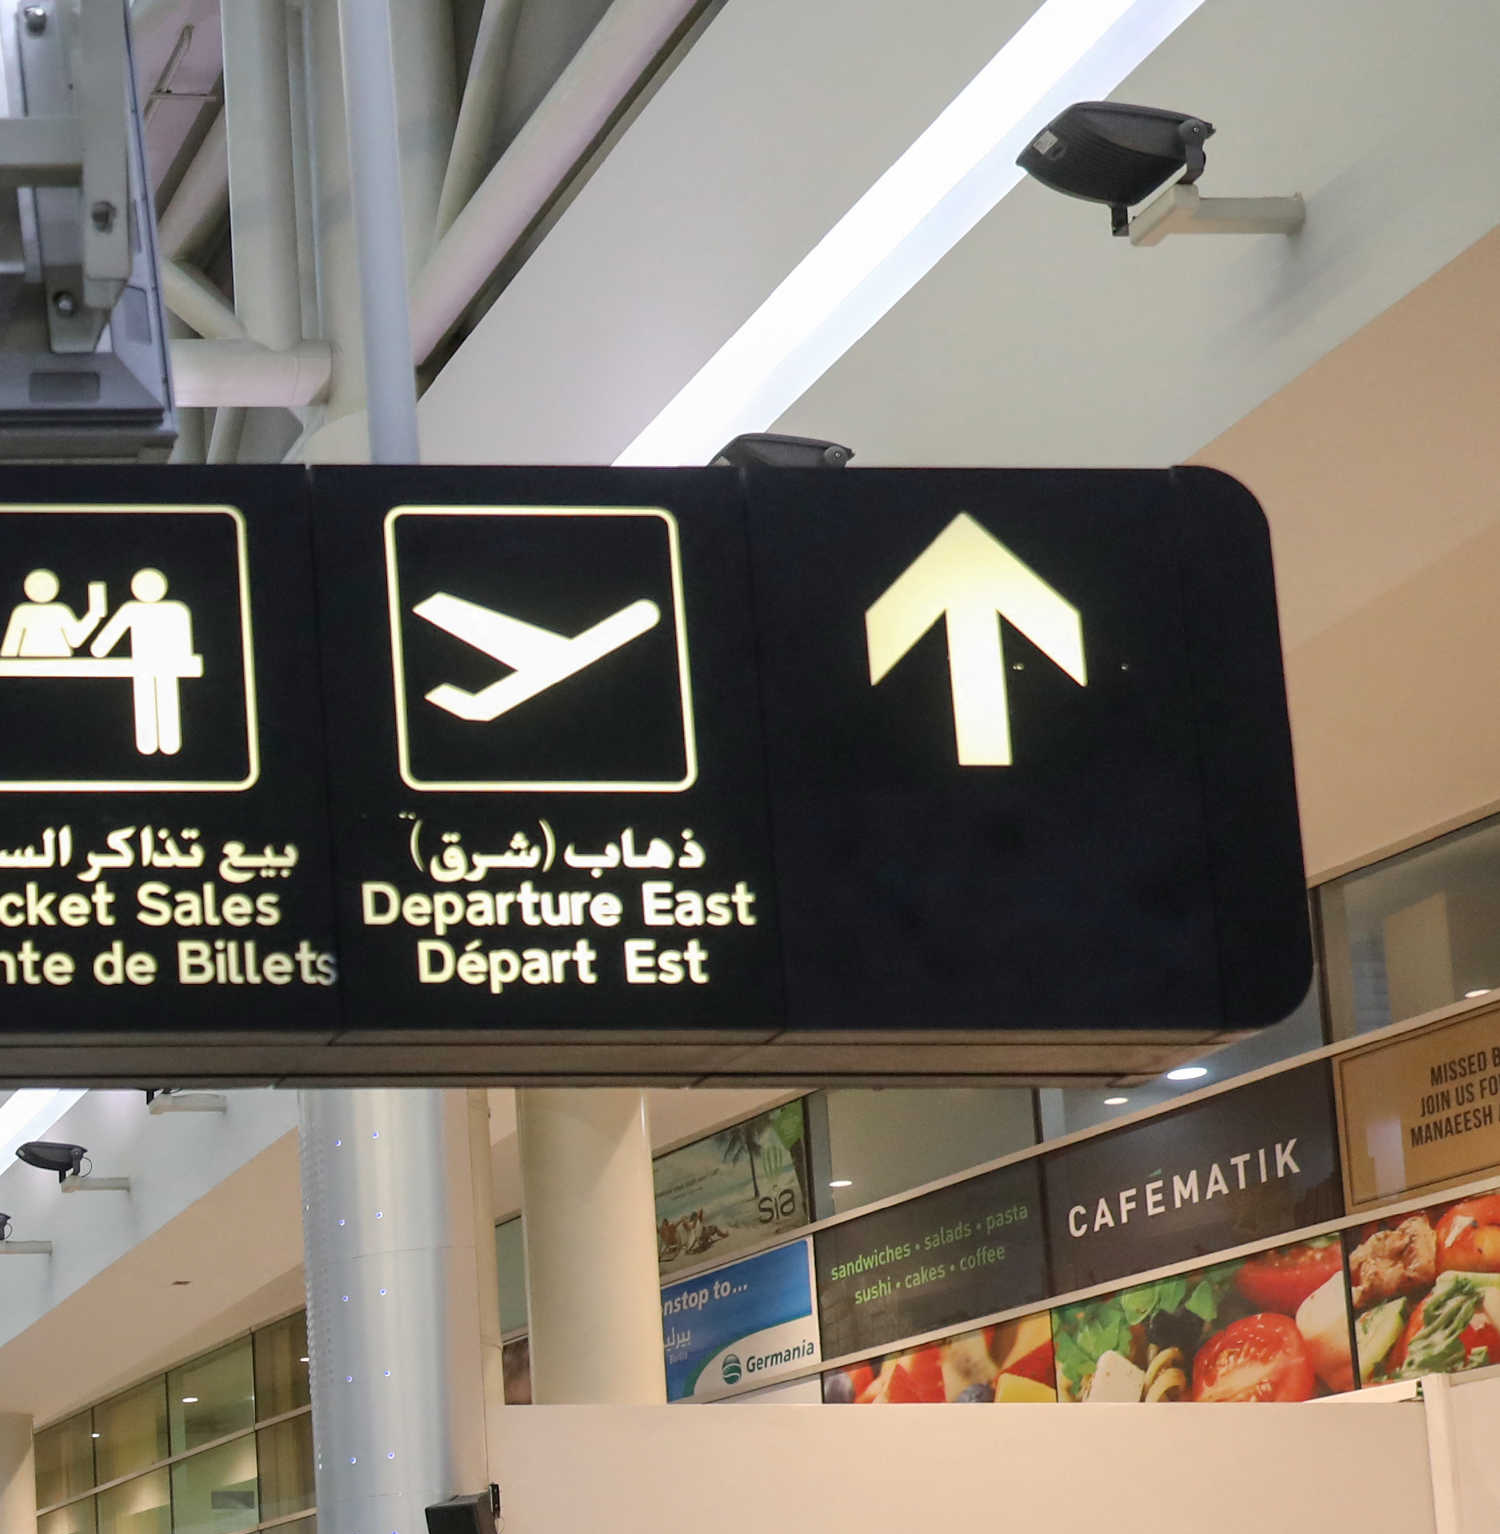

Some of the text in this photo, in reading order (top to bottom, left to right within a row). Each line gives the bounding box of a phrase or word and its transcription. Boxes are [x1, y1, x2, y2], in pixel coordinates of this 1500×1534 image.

[79, 825, 204, 882] تذاكر
[219, 835, 300, 884] بيع
[410, 819, 706, 883] ذهاب (شرق)
[136, 882, 282, 928] Sales
[361, 881, 757, 935] Departure East
[93, 940, 158, 987] de
[177, 940, 337, 986] Billets
[417, 939, 709, 994] Départ Est
[1430, 1051, 1487, 1087] MISSED
[1410, 1104, 1493, 1148] MANAEESH
[1420, 1089, 1451, 1118] JOIN
[1455, 1083, 1475, 1106] US
[1069, 1138, 1300, 1238] CAFÉMATIK
[831, 1204, 1029, 1281] sandwiches salads pasta
[855, 1245, 1006, 1305] sushi cakes coffee
[746, 1339, 814, 1373] Germania
